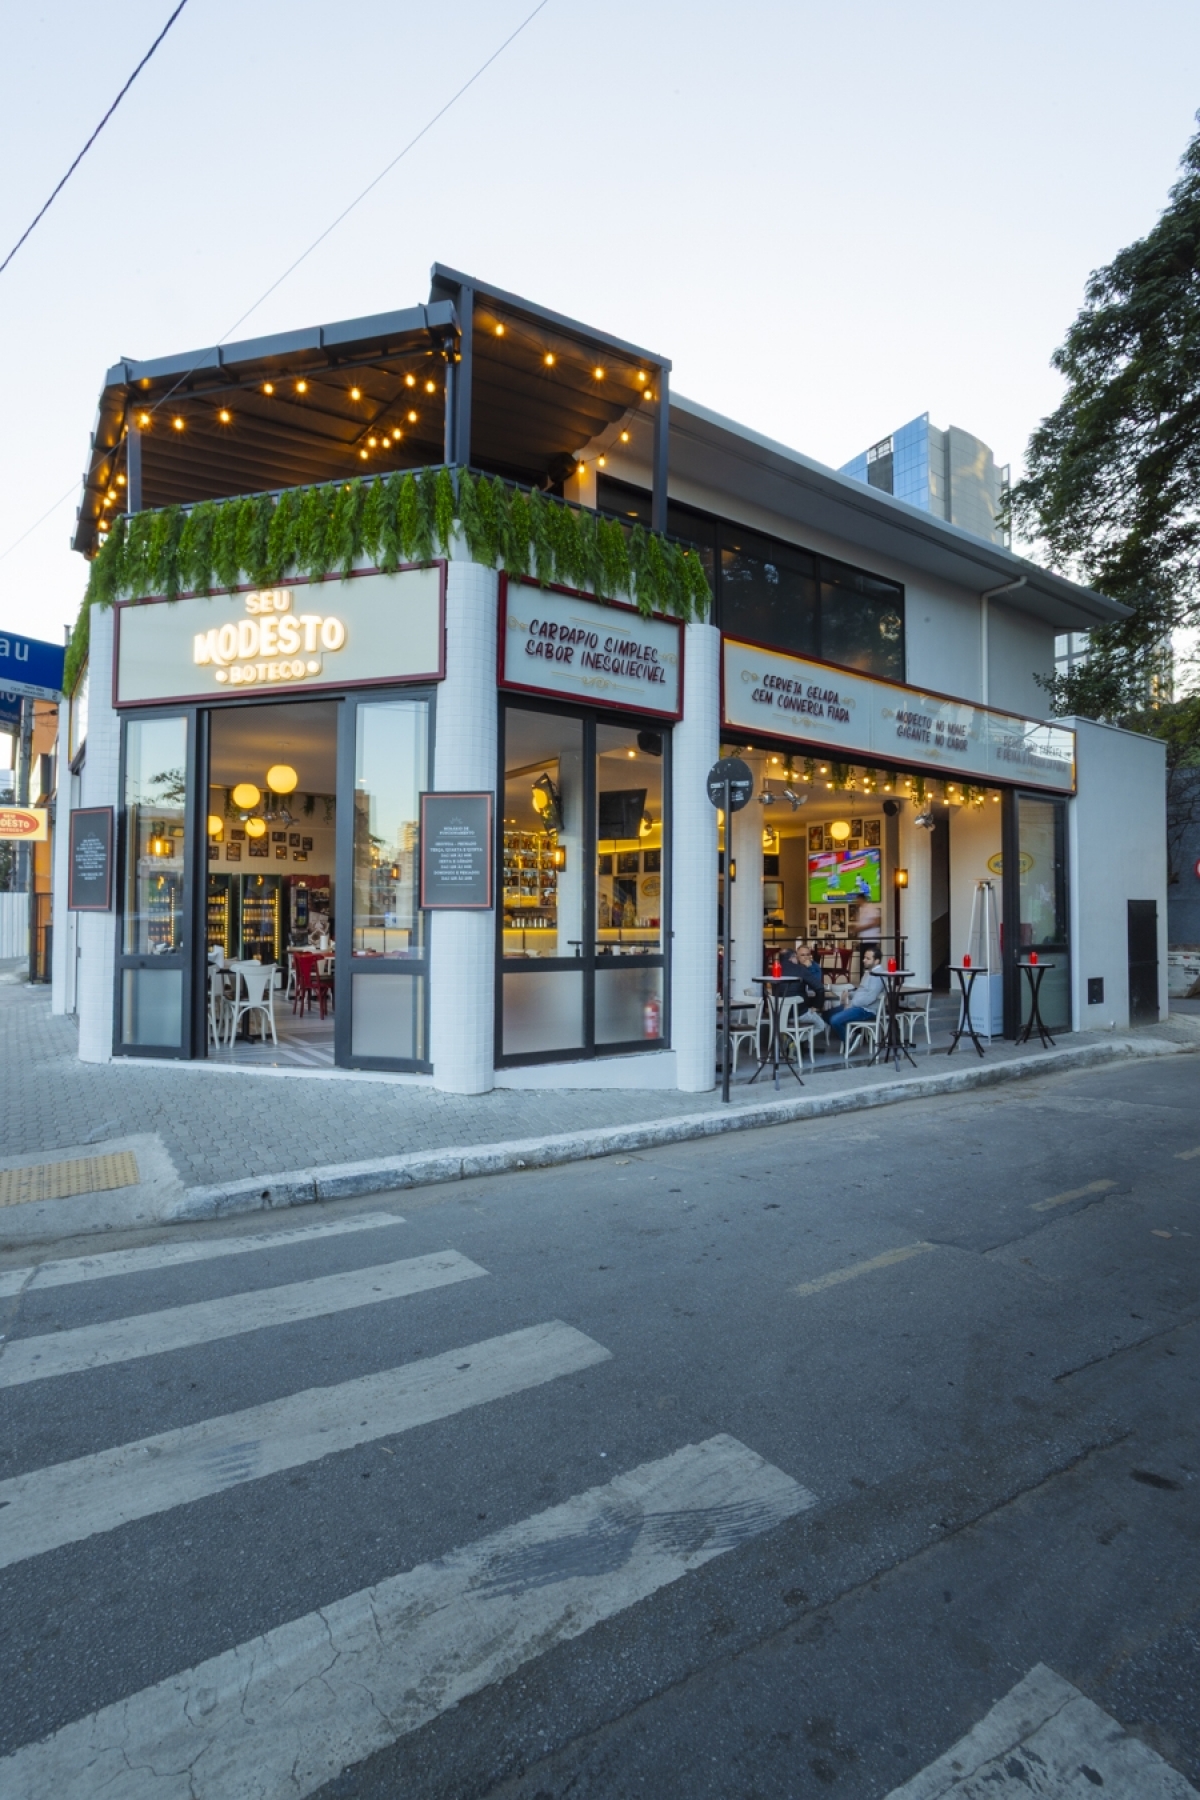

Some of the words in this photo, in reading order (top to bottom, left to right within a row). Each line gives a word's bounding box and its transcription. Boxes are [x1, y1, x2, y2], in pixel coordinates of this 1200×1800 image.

[245, 589, 291, 615] SEU
[193, 614, 346, 666] MODESTO
[525, 639, 574, 663] SABOR
[230, 659, 306, 685] BOTECO
[763, 674, 803, 696] CERVEJA
[828, 705, 851, 723] FIADA
[896, 725, 932, 744] GIGANTE
